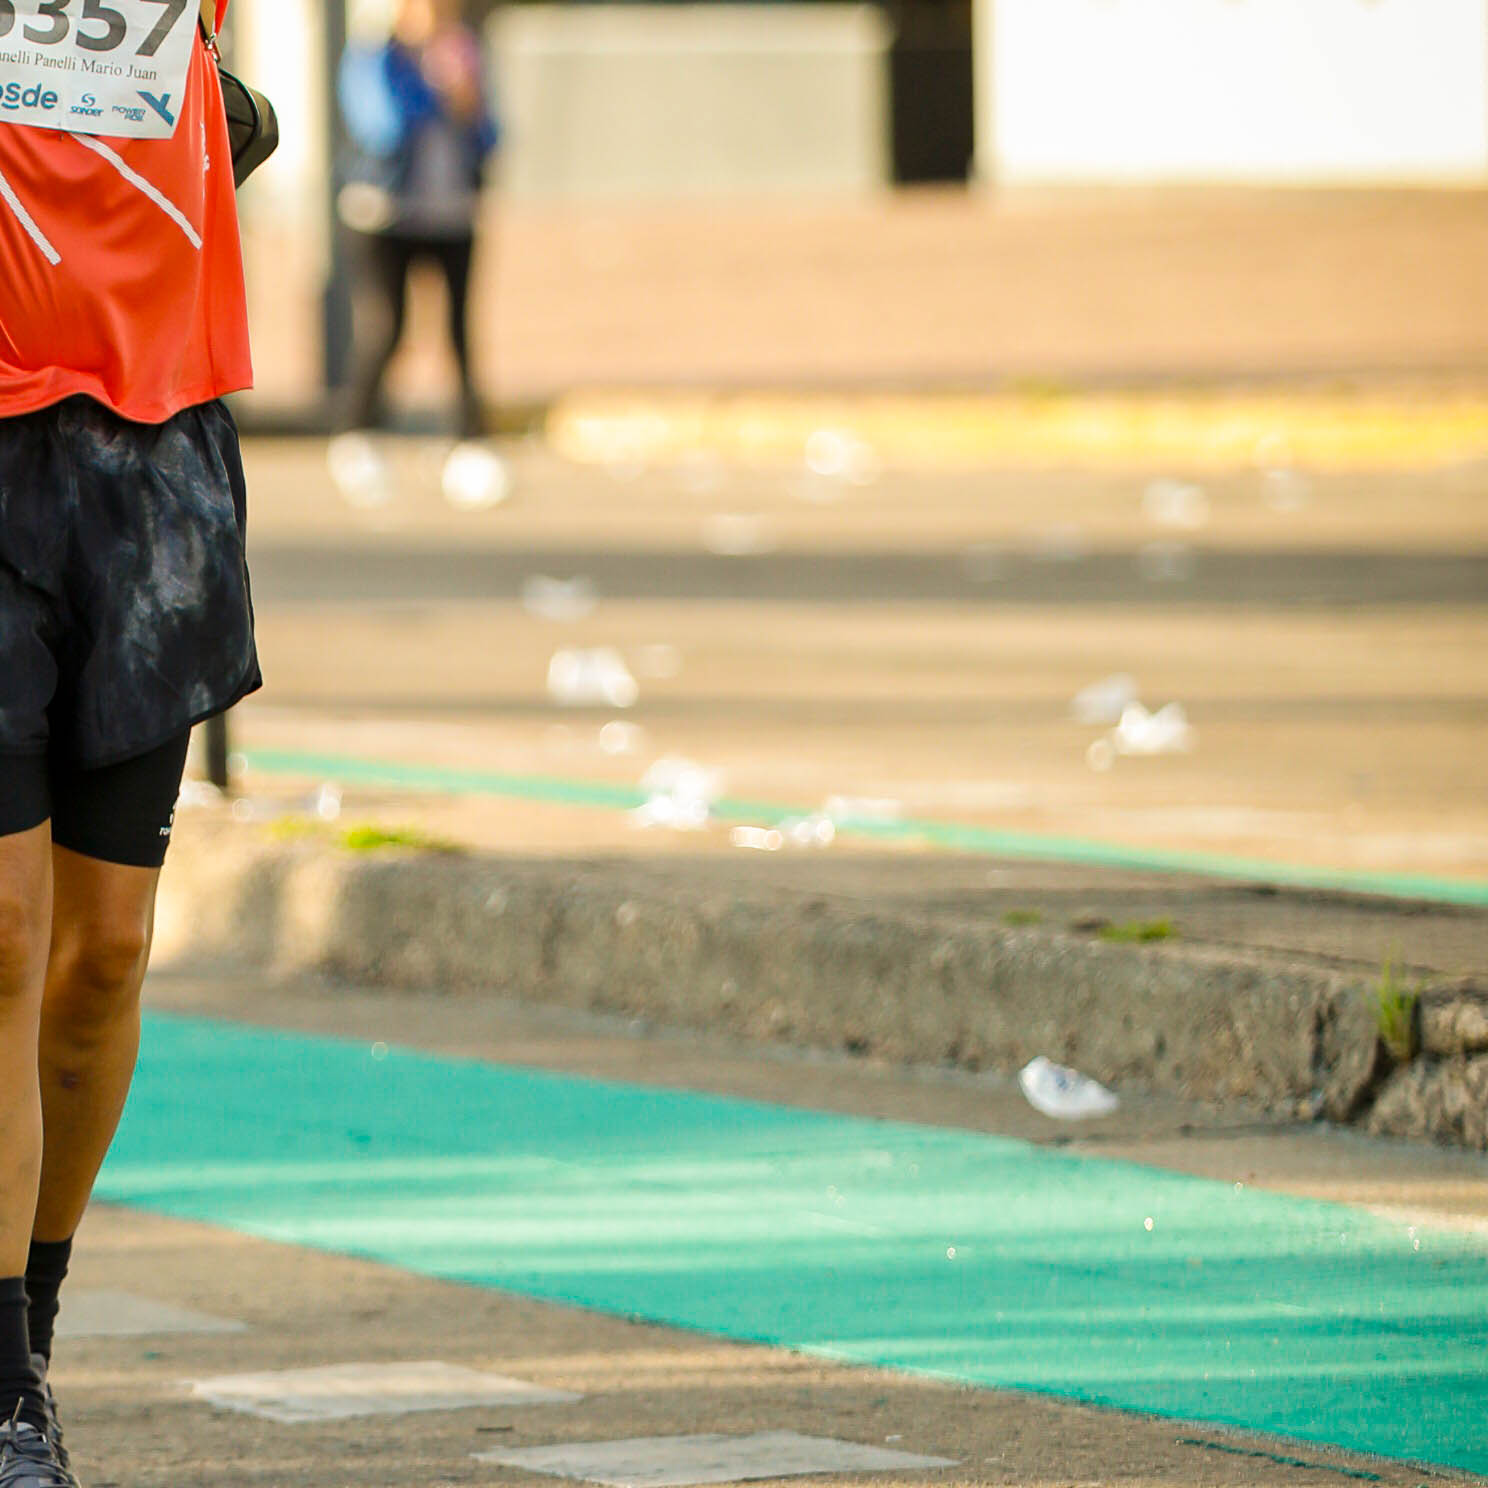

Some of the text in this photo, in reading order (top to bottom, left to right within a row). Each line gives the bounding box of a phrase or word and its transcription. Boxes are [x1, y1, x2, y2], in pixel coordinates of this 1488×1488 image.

[34, 52, 76, 71] Panelli
[81, 58, 122, 76] Mario
[126, 64, 157, 81] Juan
